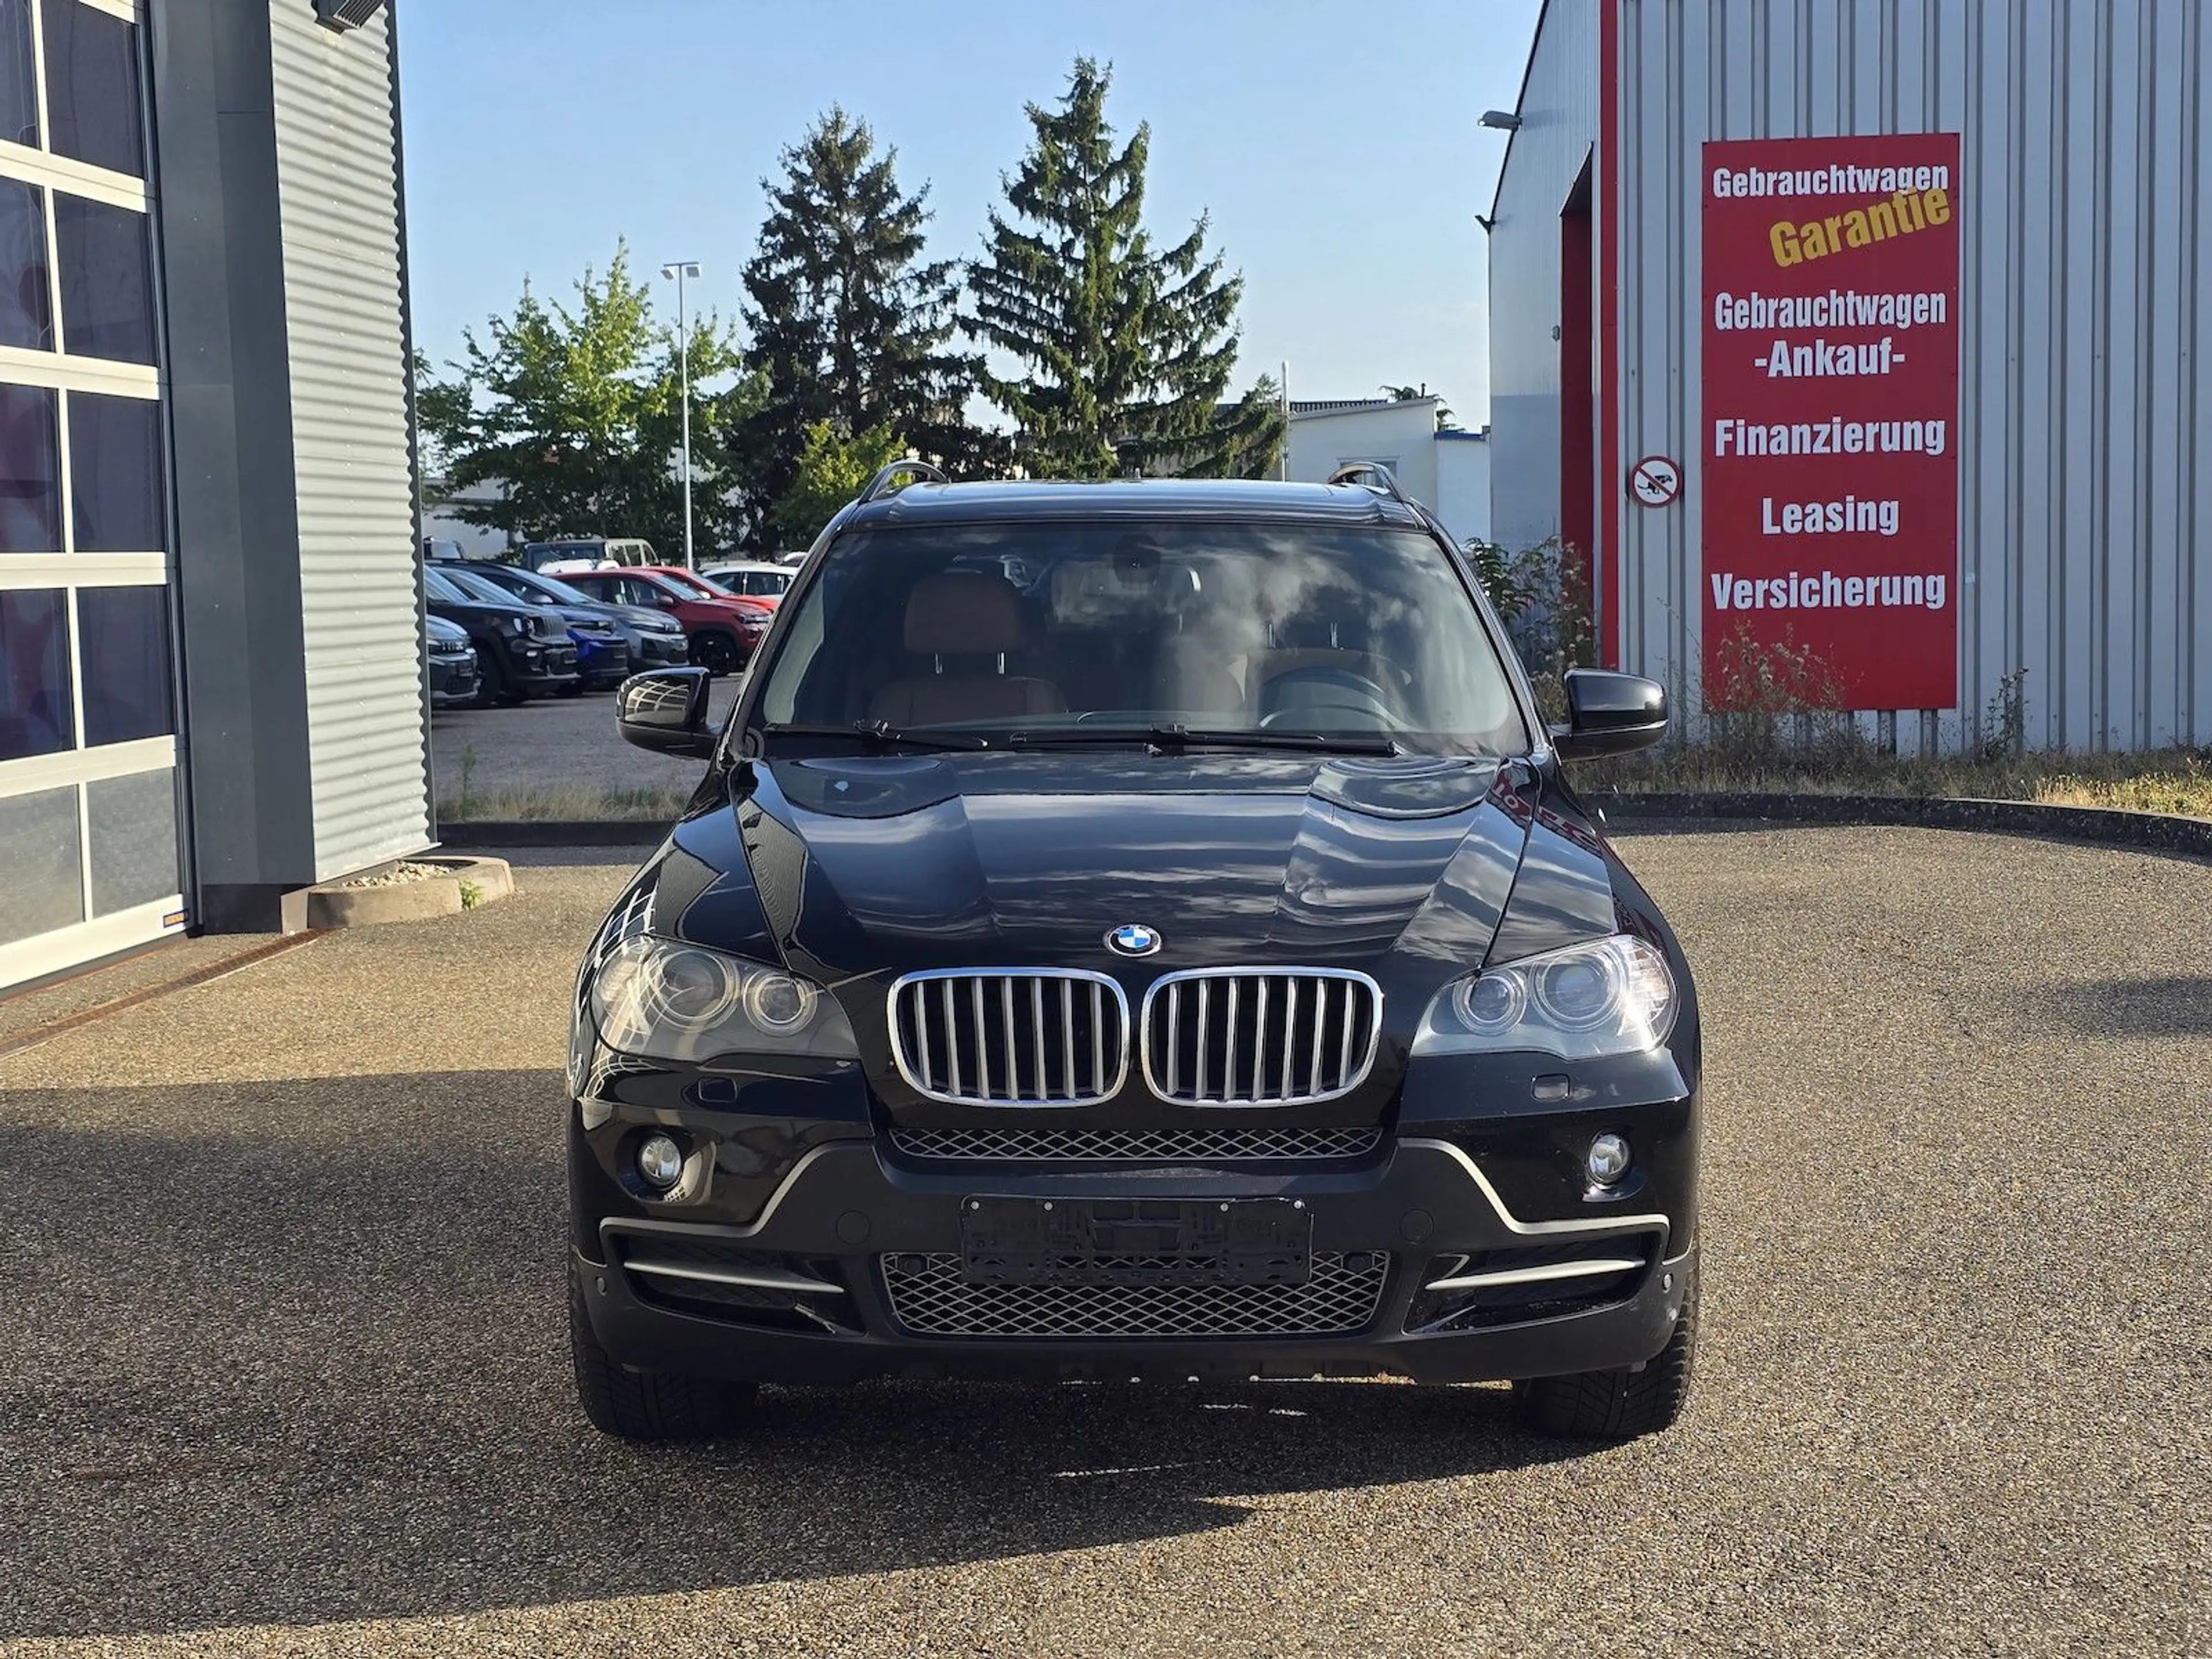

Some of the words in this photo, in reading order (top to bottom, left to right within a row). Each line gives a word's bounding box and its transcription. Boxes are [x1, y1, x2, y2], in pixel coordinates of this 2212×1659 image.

[1714, 165, 1948, 198] Gebrauchtwagen
[1770, 185, 1950, 267] Garantie
[1715, 289, 1946, 330] Gebrauchtwagen
[1755, 337, 1905, 377] -Ankauf-
[1715, 416, 1945, 456] Finanzierung
[1763, 495, 1899, 536] Leasing
[1711, 571, 1945, 609] Versicherung
